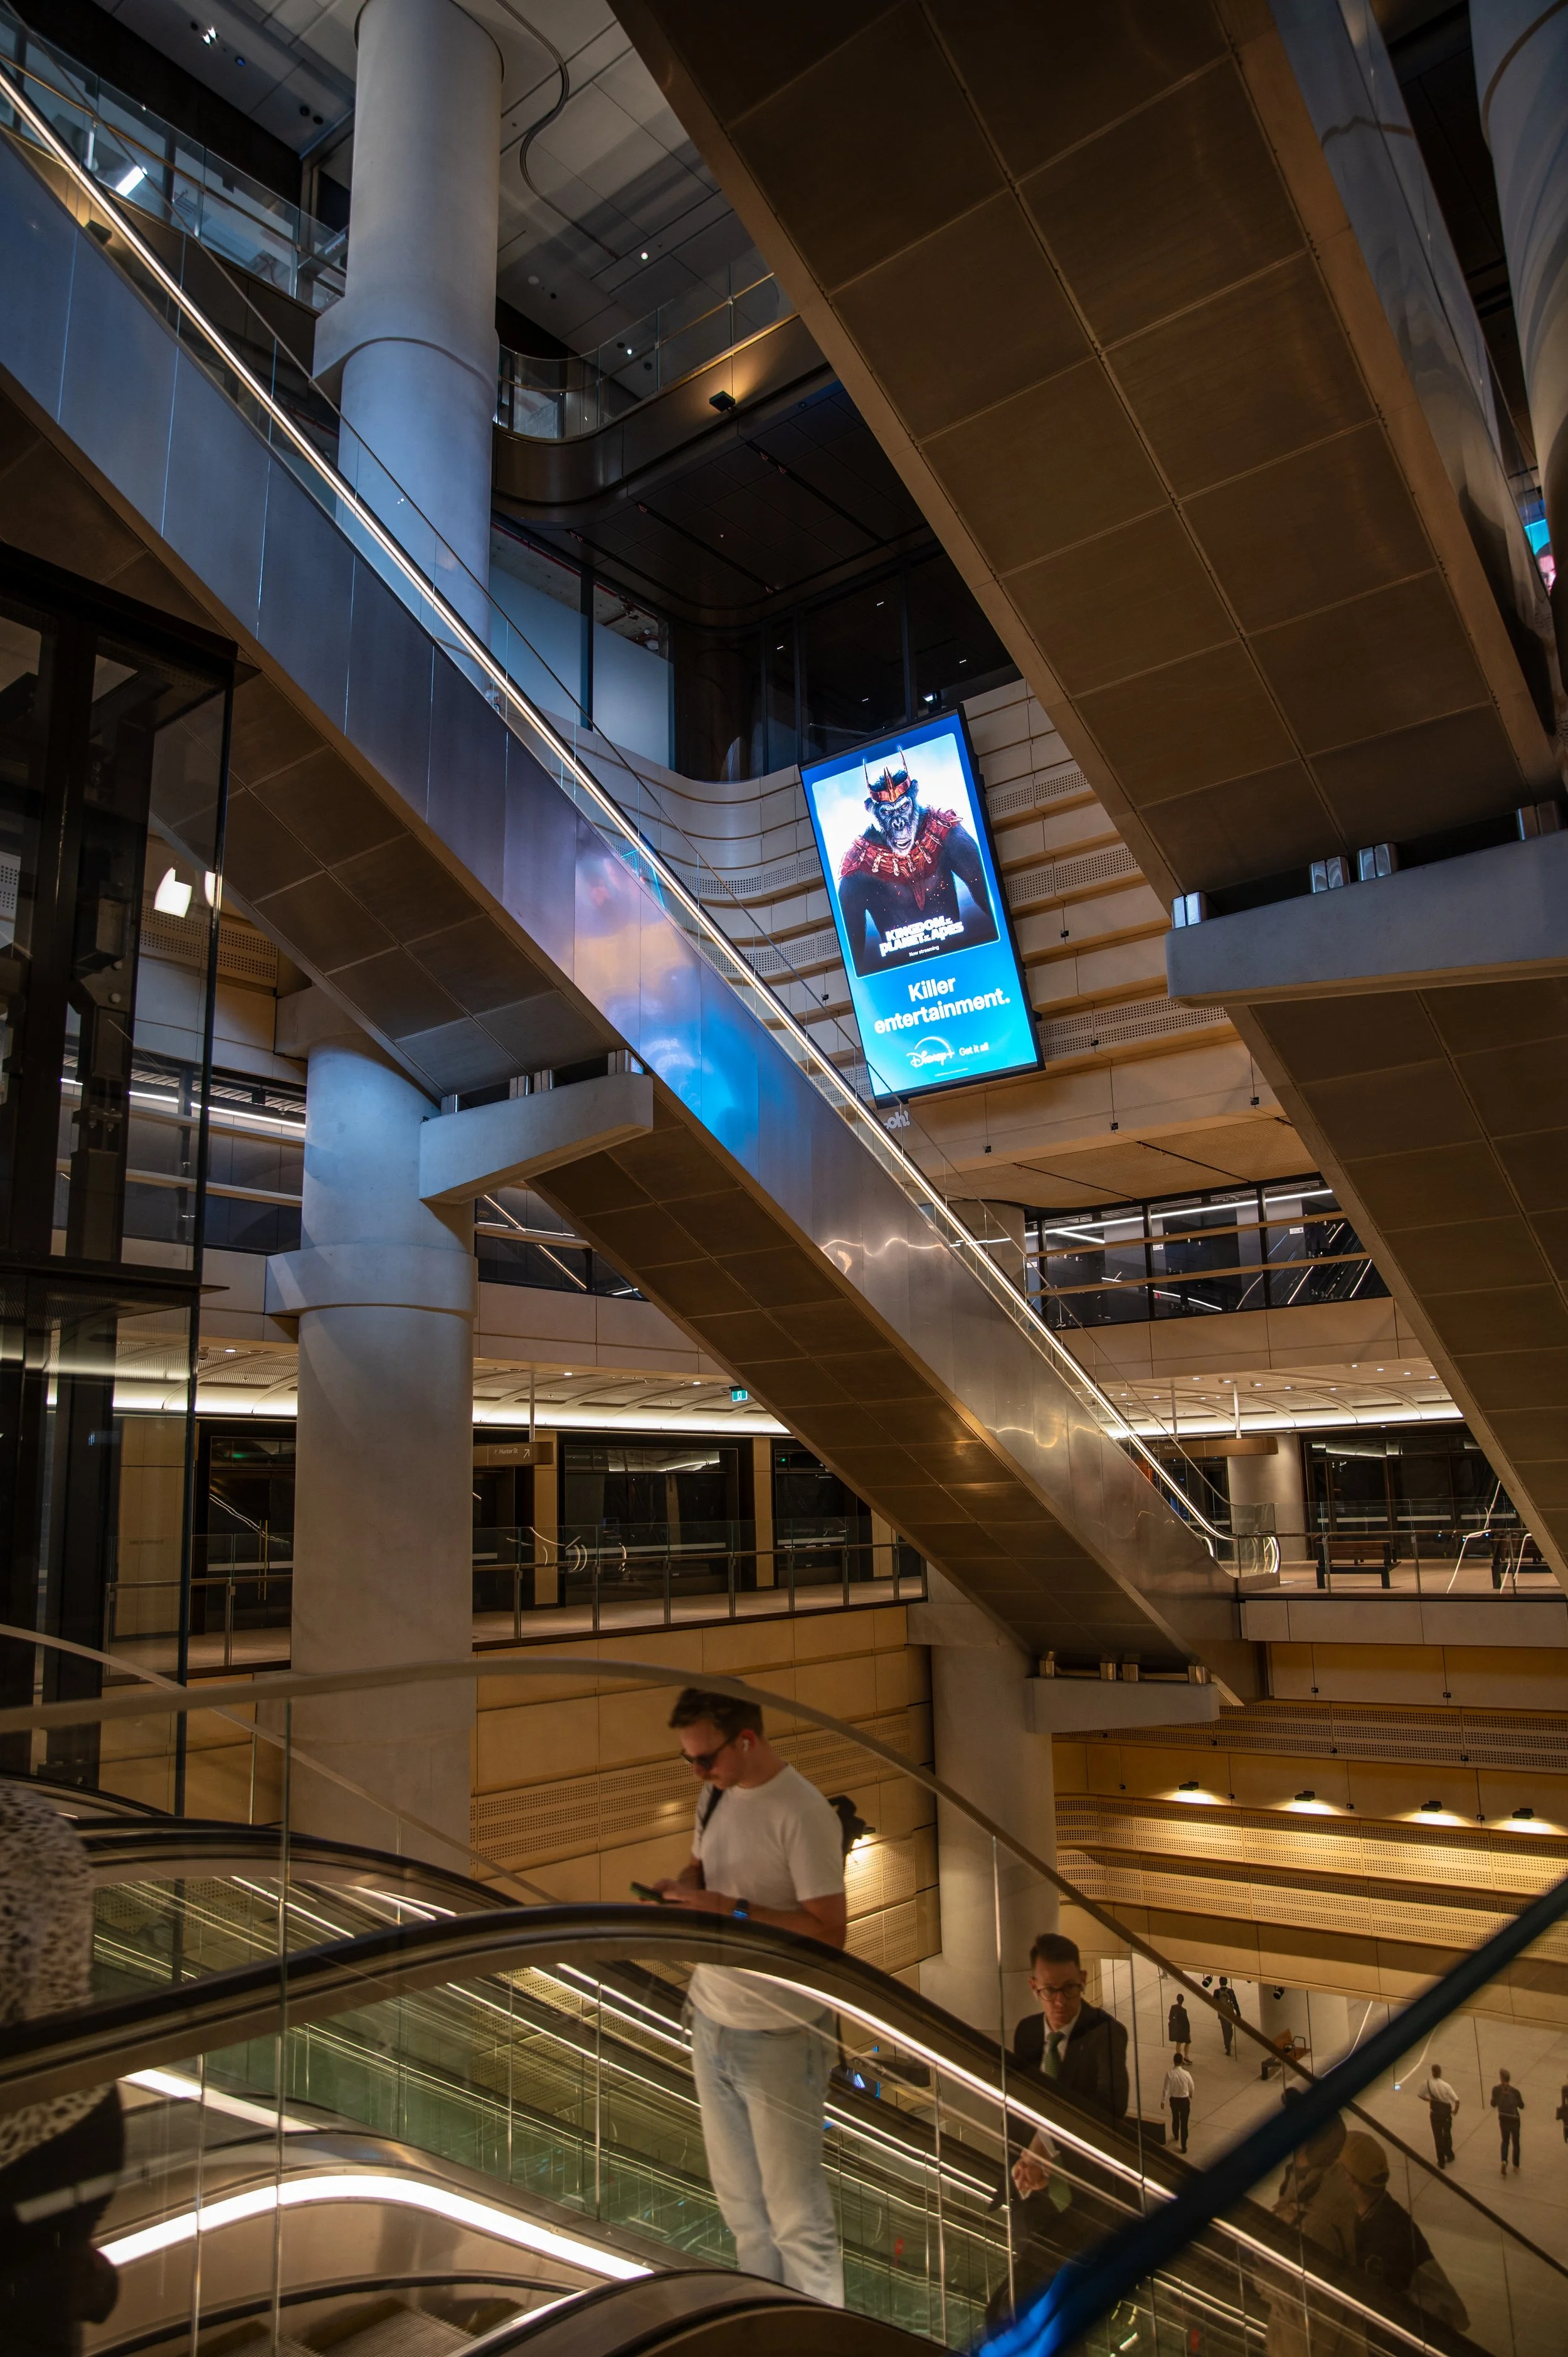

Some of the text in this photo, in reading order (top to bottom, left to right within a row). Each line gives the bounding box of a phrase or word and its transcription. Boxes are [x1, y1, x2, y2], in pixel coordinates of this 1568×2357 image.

[885, 915, 945, 941] KINGDOM
[879, 932, 924, 957] PLANET
[919, 945, 940, 954] streaming
[908, 977, 956, 1002] Killer
[874, 987, 1011, 1034] entertainment.
[958, 1046, 973, 1056] Get
[973, 1044, 980, 1053] it
